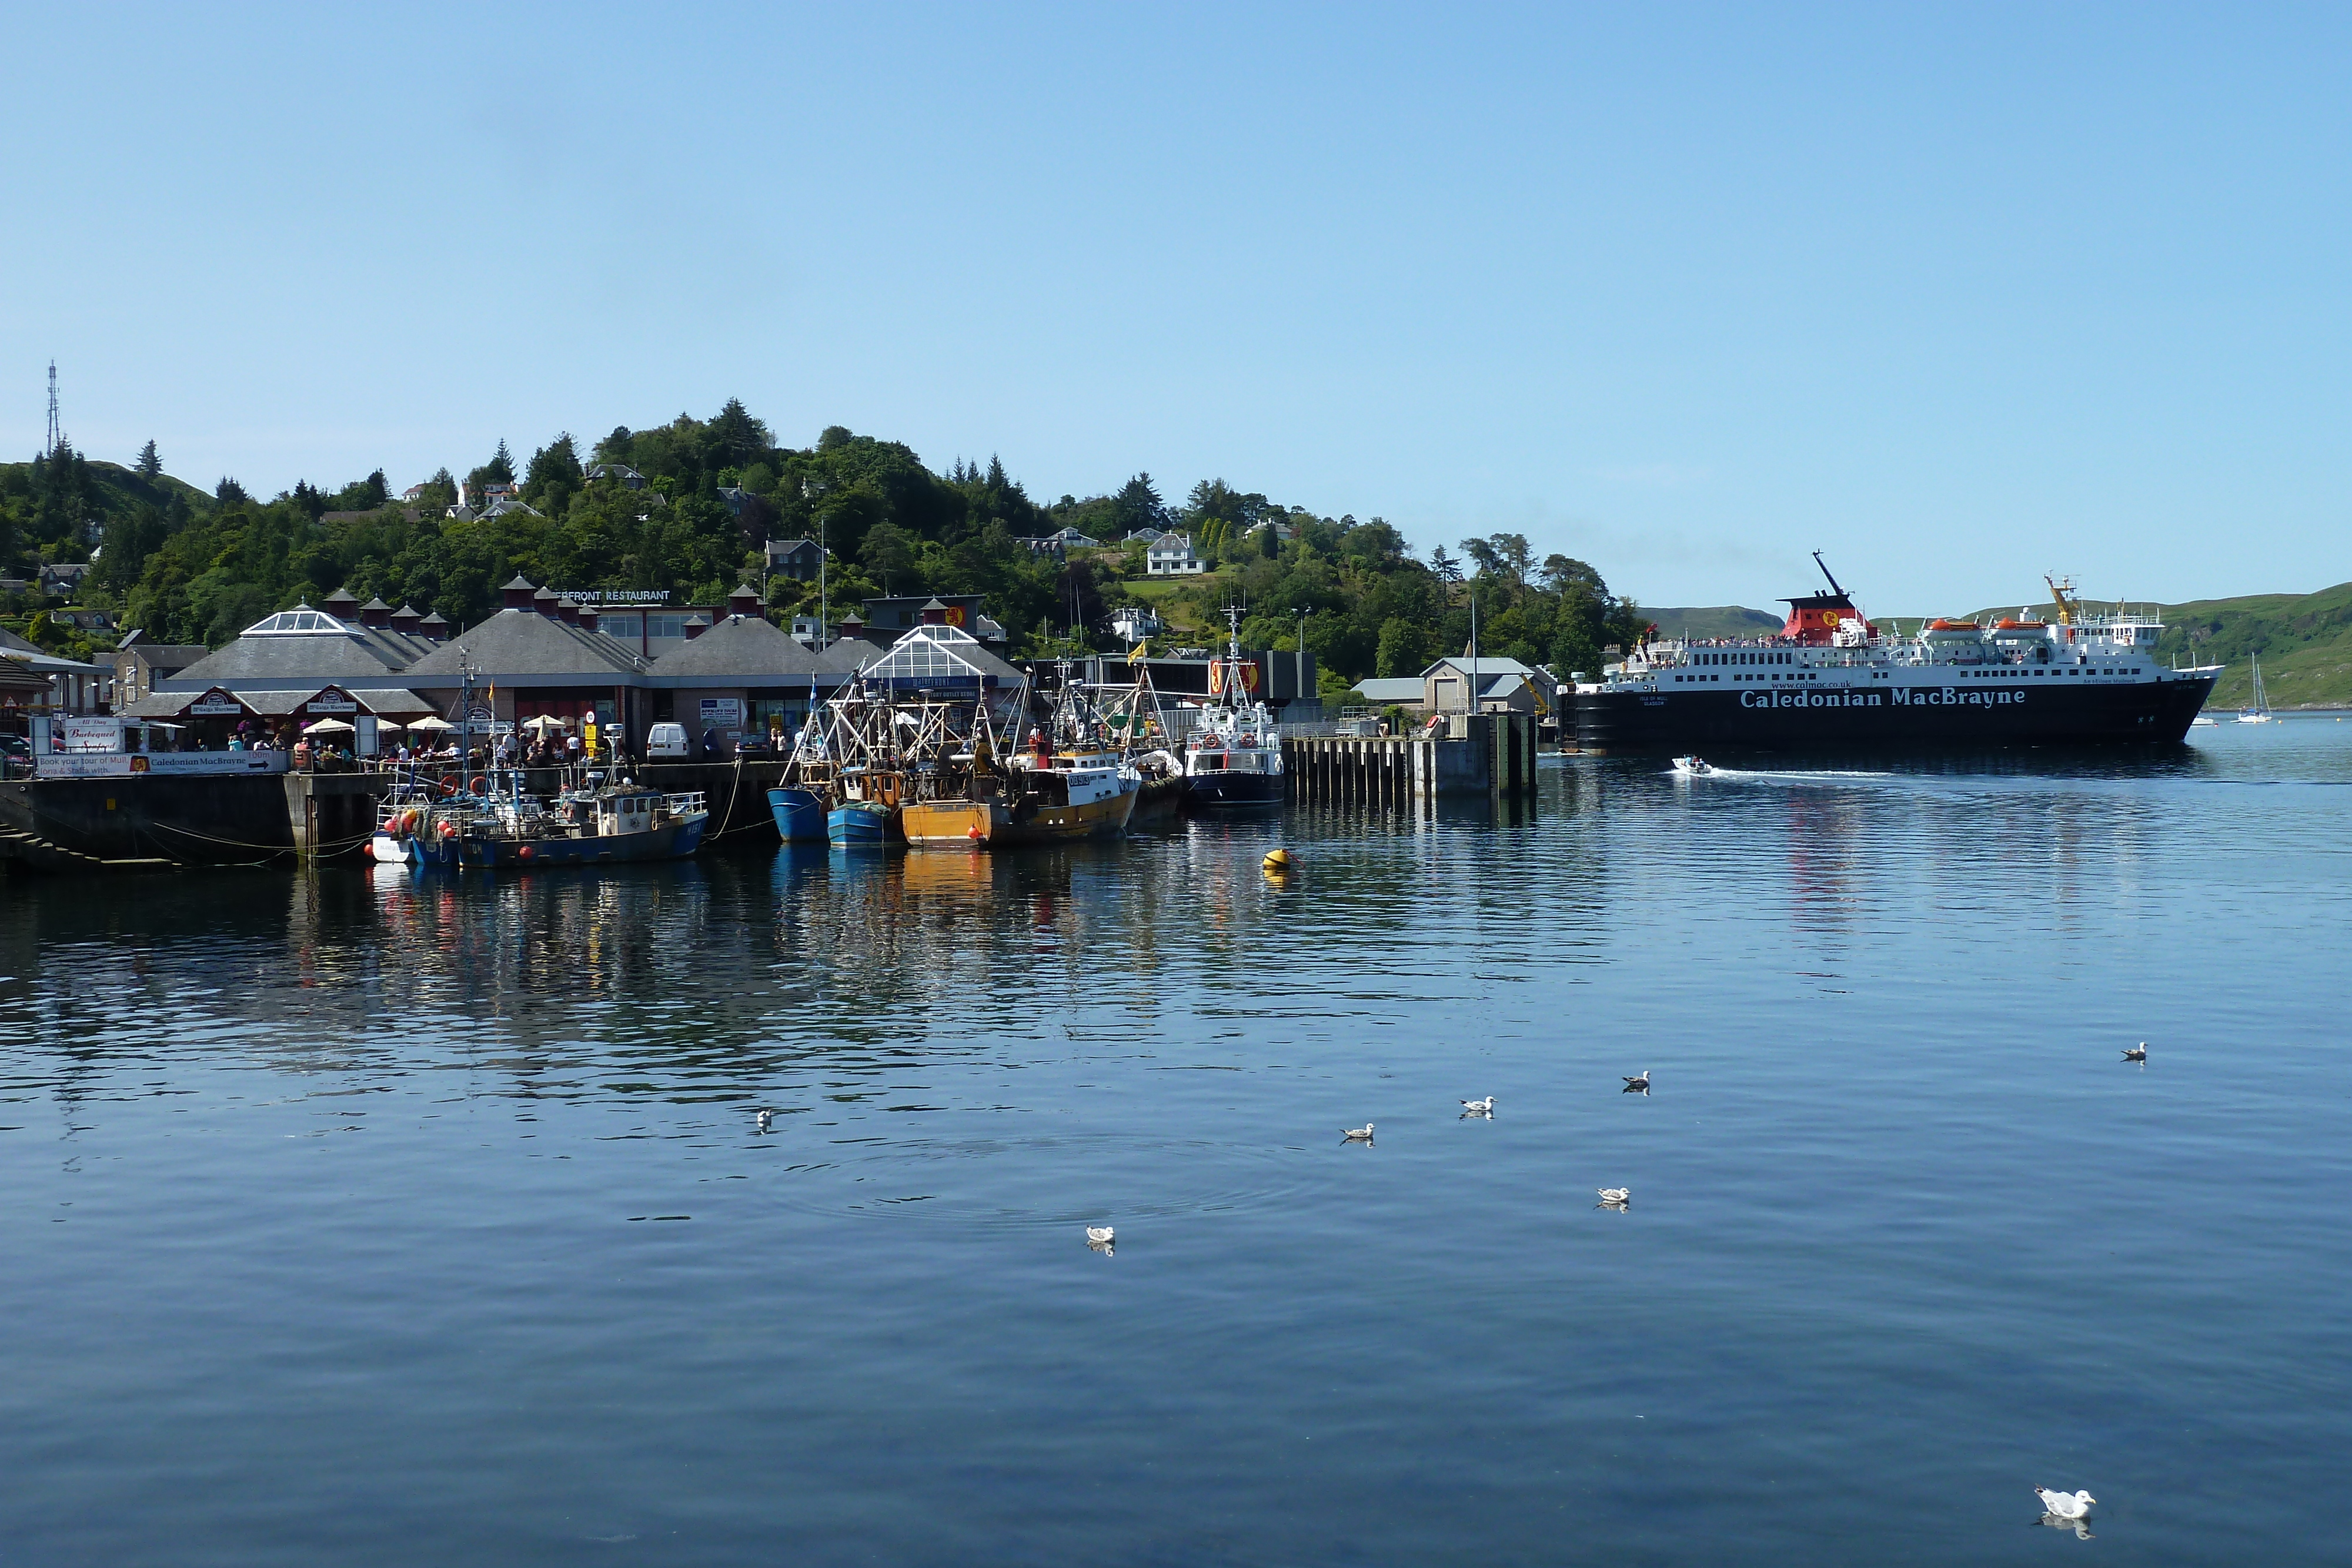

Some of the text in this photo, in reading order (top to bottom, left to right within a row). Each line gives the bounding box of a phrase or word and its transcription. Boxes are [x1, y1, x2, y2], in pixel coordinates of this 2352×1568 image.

[552, 591, 670, 601] ERFRONT RESTAURANT
[1772, 680, 1851, 689] www.calmac.co.uk
[1740, 687, 2025, 709] Caledonian MacBrayne
[69, 728, 116, 739] Barbequed
[81, 740, 116, 751] Seafood
[61, 758, 79, 767] your
[151, 757, 246, 766] Caledonian MacBrayne
